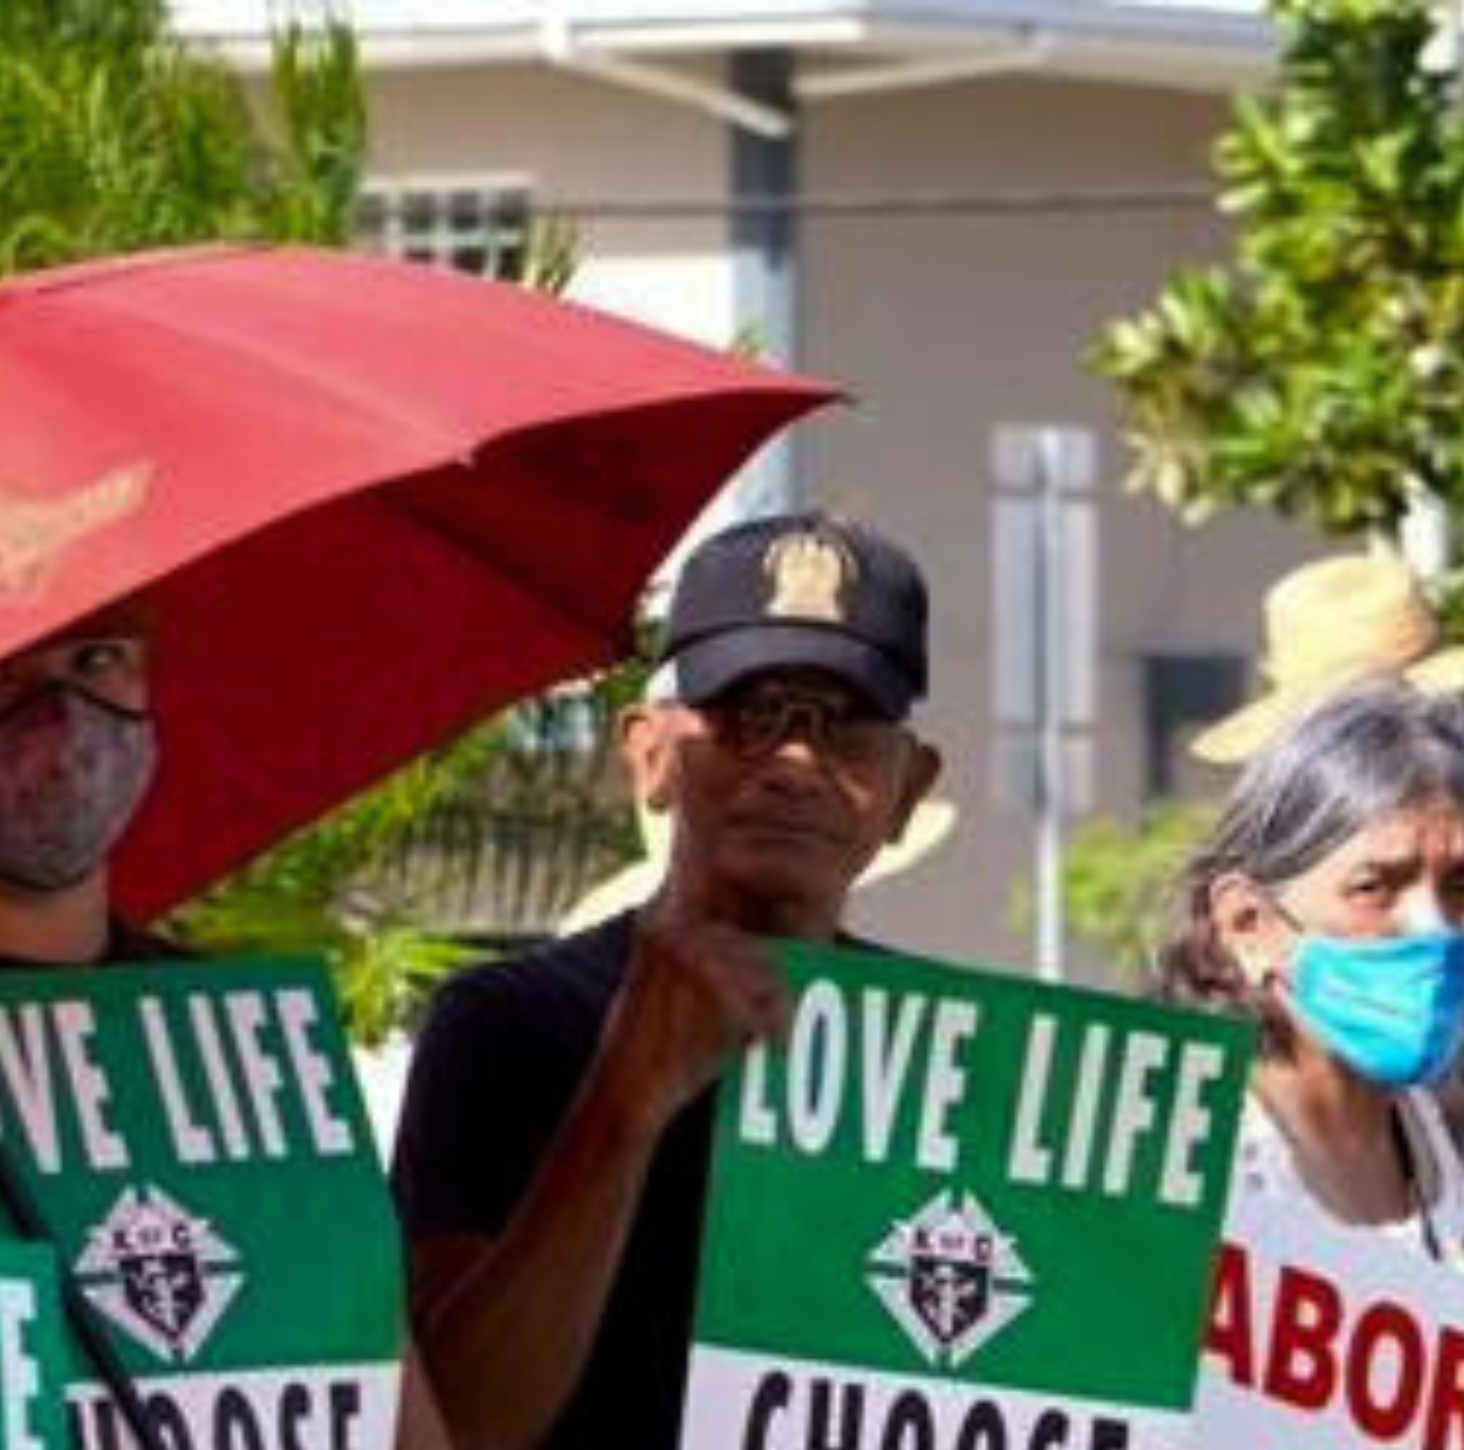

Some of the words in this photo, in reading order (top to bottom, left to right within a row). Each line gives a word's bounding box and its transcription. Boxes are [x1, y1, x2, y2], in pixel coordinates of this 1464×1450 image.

[141, 989, 355, 1162] LIFE
[738, 978, 978, 1171] LOVE
[1007, 1014, 1226, 1207] LIFE
